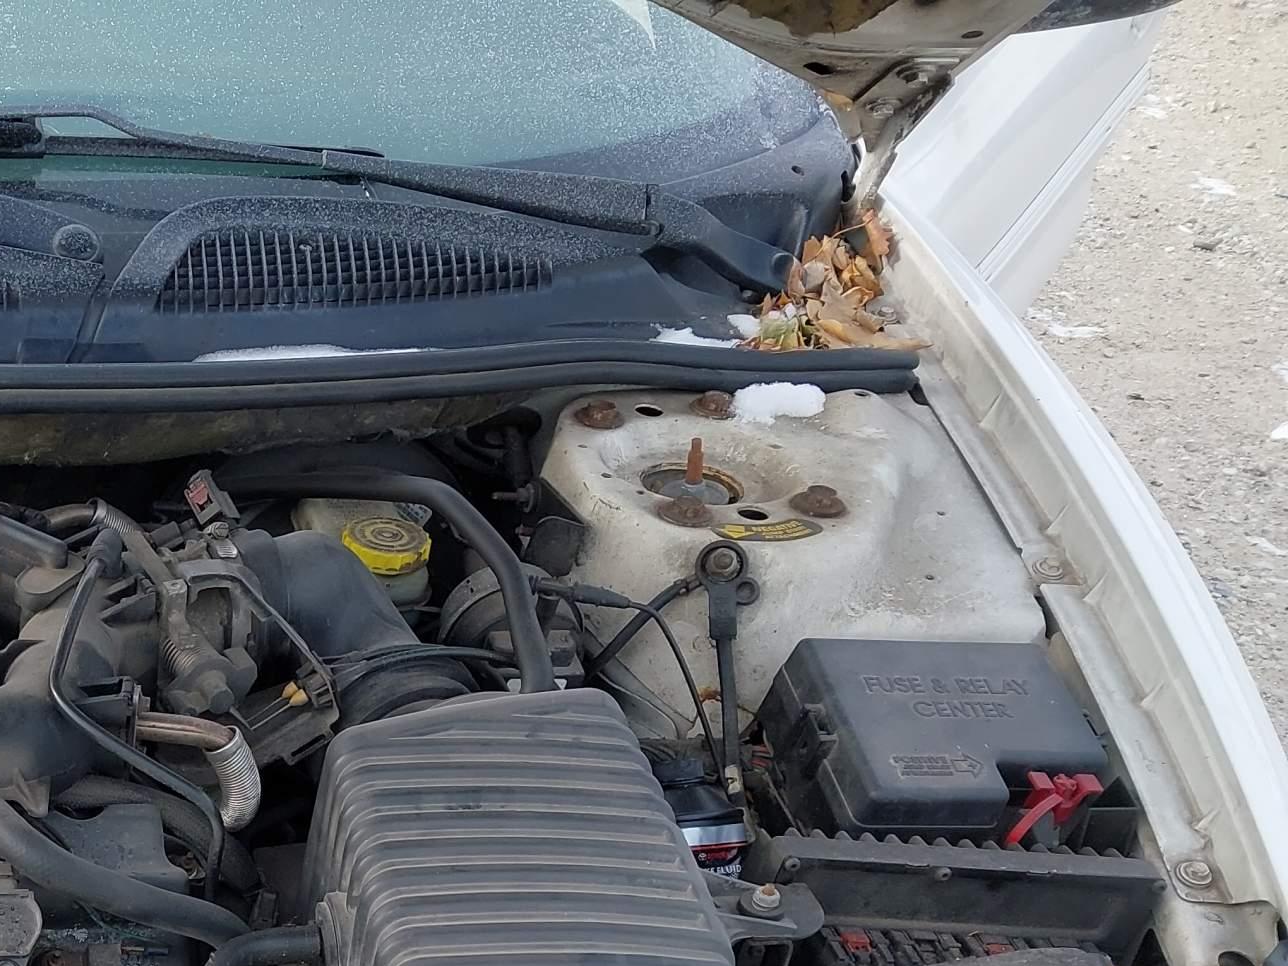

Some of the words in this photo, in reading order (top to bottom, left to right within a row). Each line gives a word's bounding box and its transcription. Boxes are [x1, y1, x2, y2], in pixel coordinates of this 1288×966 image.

[862, 675, 925, 694] FUSE
[930, 678, 951, 694] &
[954, 678, 1030, 696] RELAY
[913, 701, 1015, 719] CENTER
[717, 865, 742, 873] FLUID
